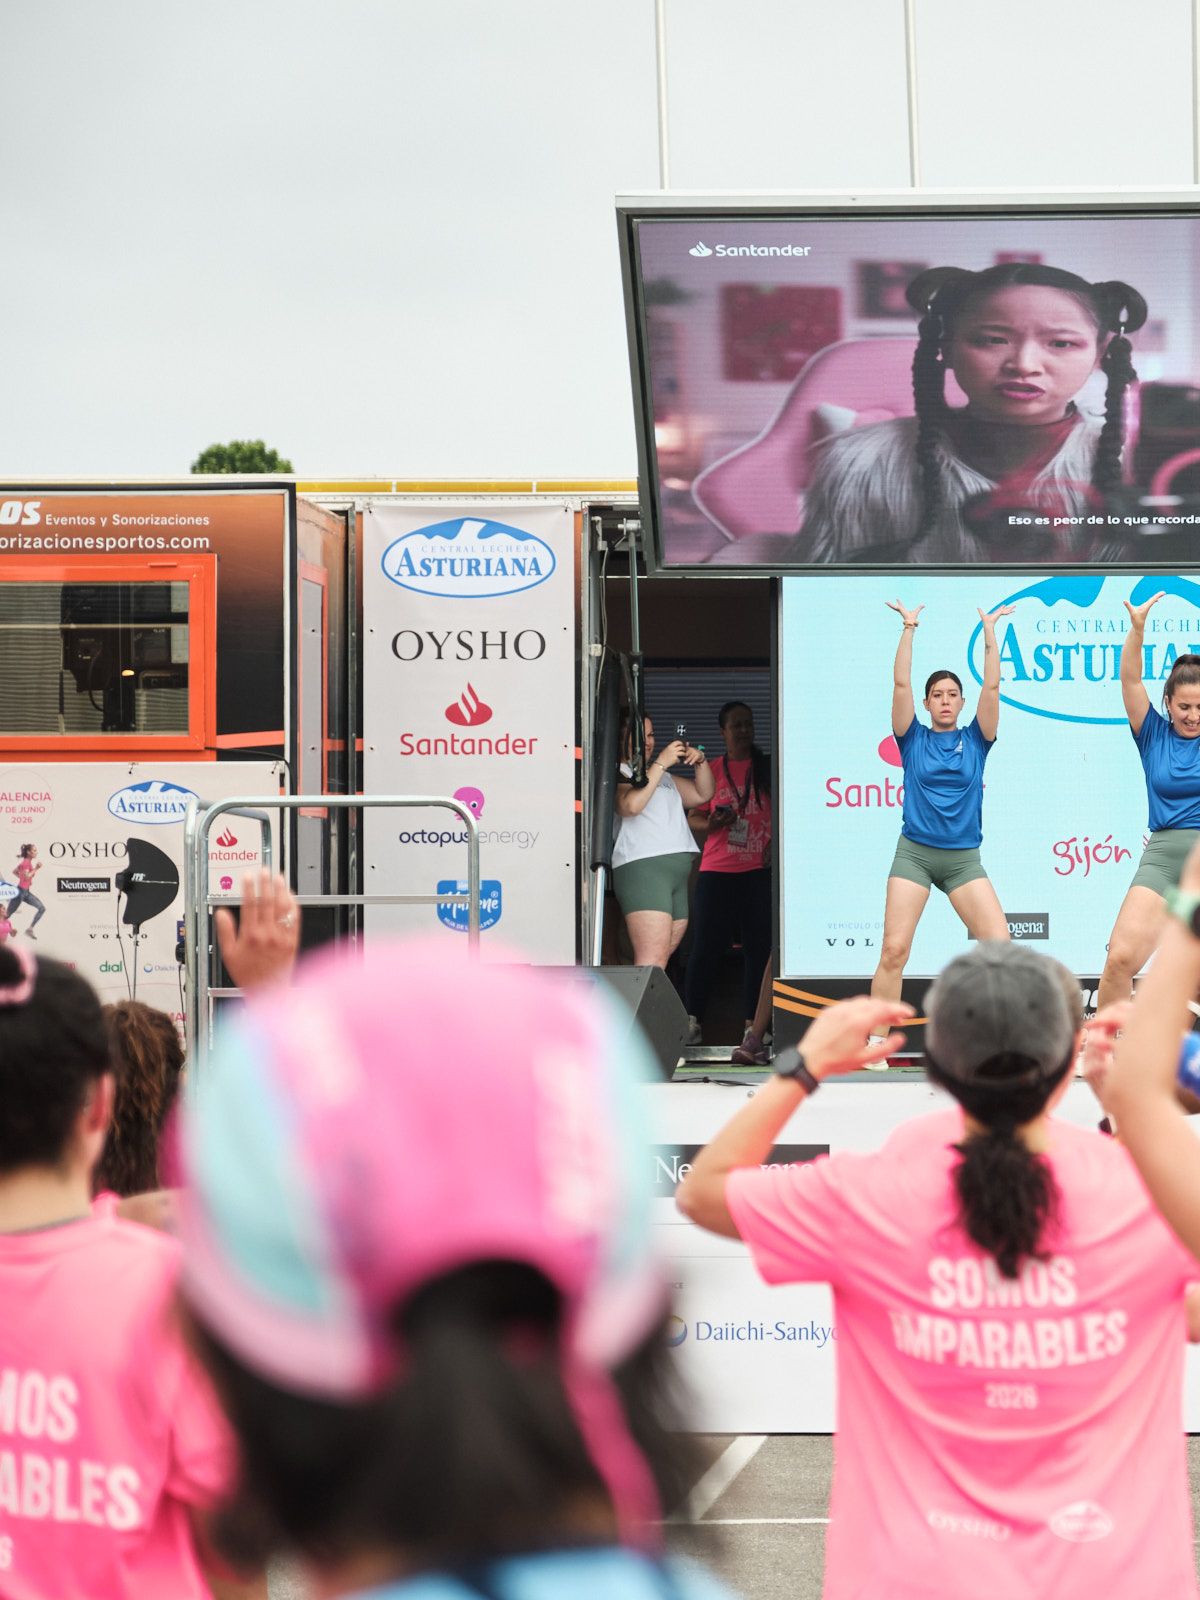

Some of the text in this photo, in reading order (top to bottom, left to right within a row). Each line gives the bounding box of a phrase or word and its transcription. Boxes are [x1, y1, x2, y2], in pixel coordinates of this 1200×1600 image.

[715, 244, 811, 257] Santander
[45, 513, 96, 526] Eventos
[100, 516, 108, 528] y
[112, 513, 210, 526] Sonorizaciones
[1008, 516, 1032, 525] Eso
[1035, 517, 1050, 525] es
[1054, 517, 1085, 527] peor
[1087, 515, 1104, 525] de
[1108, 515, 1121, 525] lo
[1124, 516, 1149, 527] que
[421, 545, 537, 553] CENTRAL LECHERA
[394, 547, 543, 577] ASTURIANA
[1036, 619, 1128, 633] CENTRAL
[391, 629, 546, 661] OYSHO
[400, 733, 538, 756] Santander
[115, 797, 187, 813] ASTURIAN
[478, 831, 540, 849] energy
[49, 842, 128, 858] OYSHO
[1052, 834, 1132, 877] gijón
[60, 880, 108, 891] Neutrogena
[99, 960, 122, 972] dial
